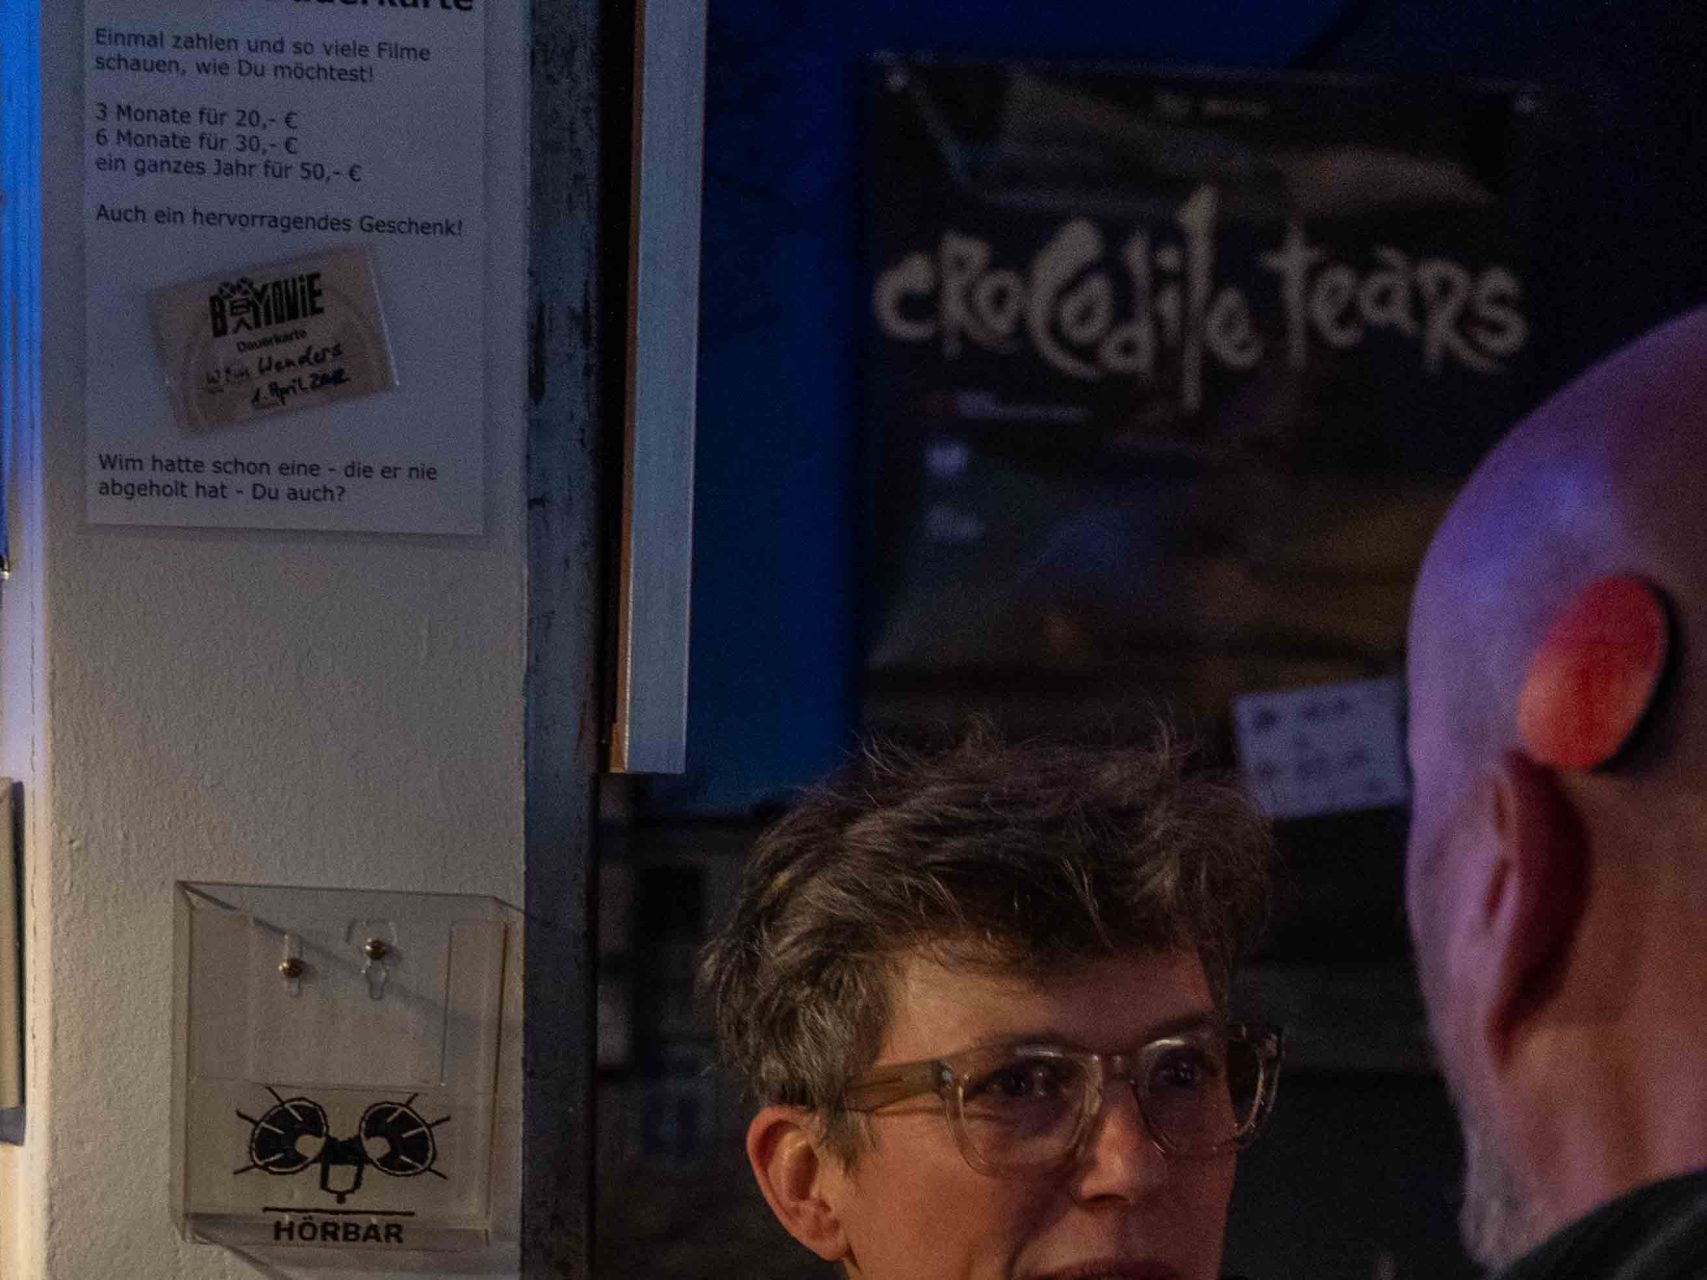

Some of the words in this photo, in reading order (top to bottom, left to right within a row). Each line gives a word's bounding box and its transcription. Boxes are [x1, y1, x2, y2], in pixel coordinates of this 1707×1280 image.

[95, 28, 164, 48] Einmal
[172, 31, 239, 51] zahlen
[247, 35, 285, 53] und
[292, 40, 314, 55] so
[323, 40, 369, 57] viele
[377, 41, 431, 61] Filme
[95, 53, 187, 76] schauen,
[196, 58, 230, 76] wie
[238, 58, 266, 77] Du
[274, 62, 374, 83] möchtest!
[95, 103, 107, 121] 3
[116, 104, 191, 125] Monate
[199, 106, 228, 126] für
[235, 109, 277, 129] 20,-
[285, 112, 298, 130] €
[95, 128, 108, 146] 6
[116, 129, 191, 149] Monate
[199, 131, 228, 151] für
[235, 134, 277, 154] 30,-
[285, 136, 298, 154] €
[95, 155, 126, 171] ein
[134, 158, 206, 177] ganzes
[213, 158, 256, 178] Jahr
[263, 160, 292, 179] für
[300, 162, 340, 183] 50,-
[349, 164, 361, 182] €
[96, 204, 146, 225] Auch
[154, 206, 185, 226] ein
[192, 208, 352, 234] hervorragendes
[359, 215, 463, 237] Geschenk!
[236, 329, 308, 353] Dauerkarte
[99, 453, 144, 472] Wim
[152, 455, 205, 475] hatte
[213, 457, 271, 476] schon
[278, 459, 321, 477] eine
[344, 461, 374, 479] die
[380, 464, 402, 480] er
[408, 463, 438, 481] nie
[99, 479, 189, 500] abgeholt
[195, 481, 228, 499] hat
[252, 482, 279, 500] Du
[287, 484, 346, 502] auch?
[274, 1214, 404, 1244] HÖRBAR
